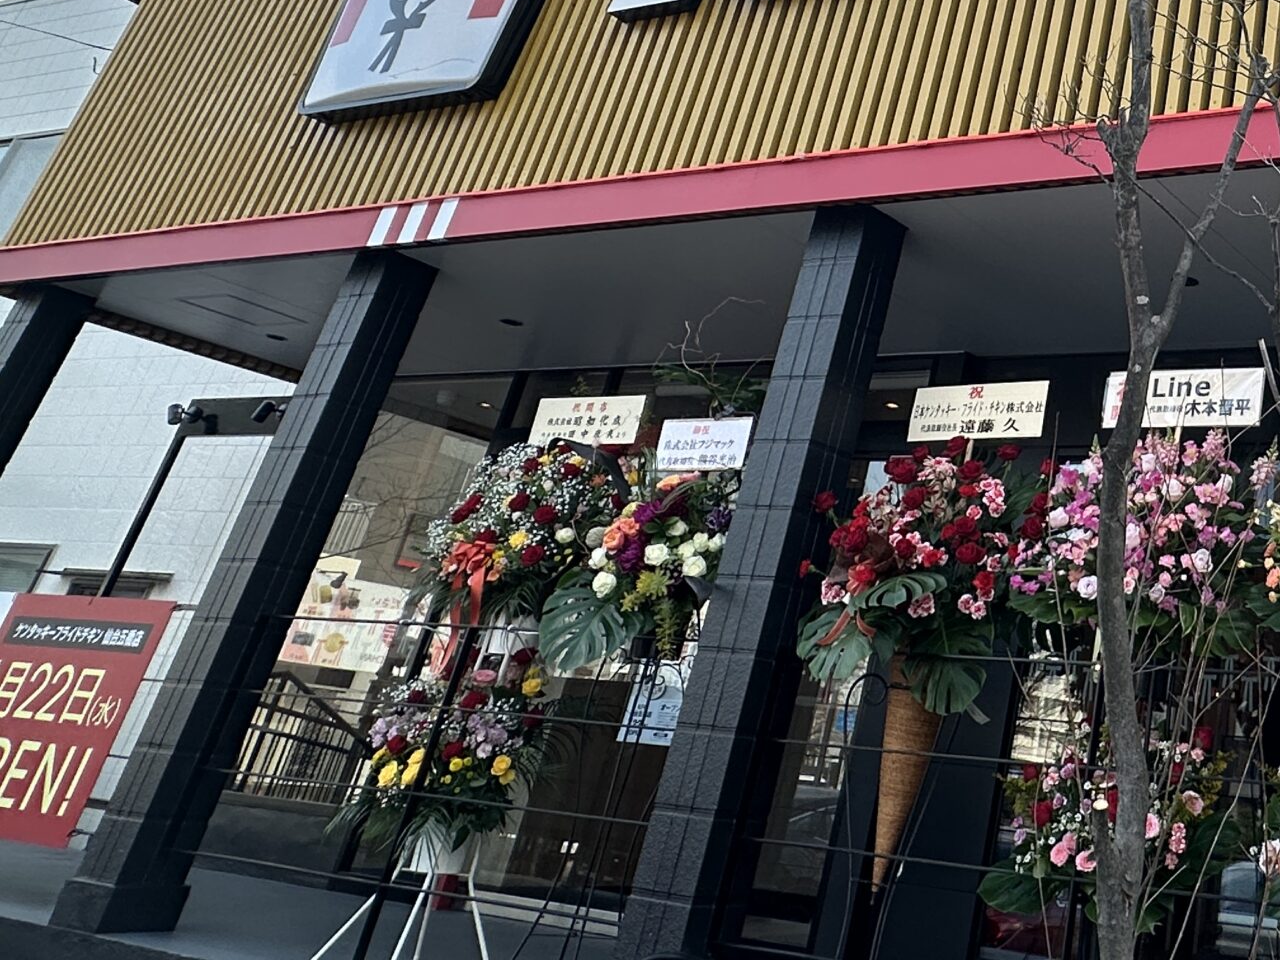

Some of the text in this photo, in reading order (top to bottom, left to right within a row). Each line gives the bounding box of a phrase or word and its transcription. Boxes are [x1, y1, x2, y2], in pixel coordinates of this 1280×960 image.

[969, 386, 984, 399] 祝
[1152, 377, 1211, 398] Line
[13, 622, 103, 644] ケンタッキーフライドチキン
[0, 659, 122, 729] 月22日(水)
